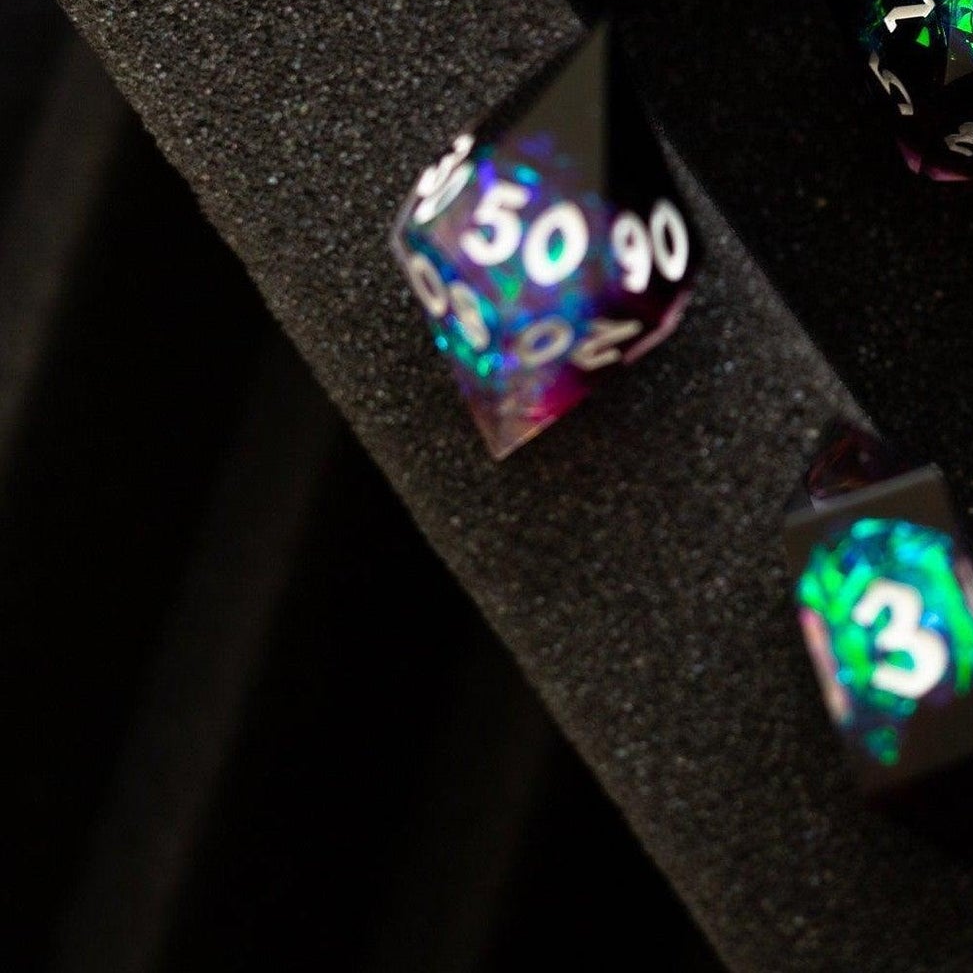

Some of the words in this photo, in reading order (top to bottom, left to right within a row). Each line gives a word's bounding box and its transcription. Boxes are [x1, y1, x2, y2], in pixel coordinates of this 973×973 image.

[460, 180, 589, 287] 50
[611, 198, 689, 294] 90
[852, 577, 949, 699] 3
